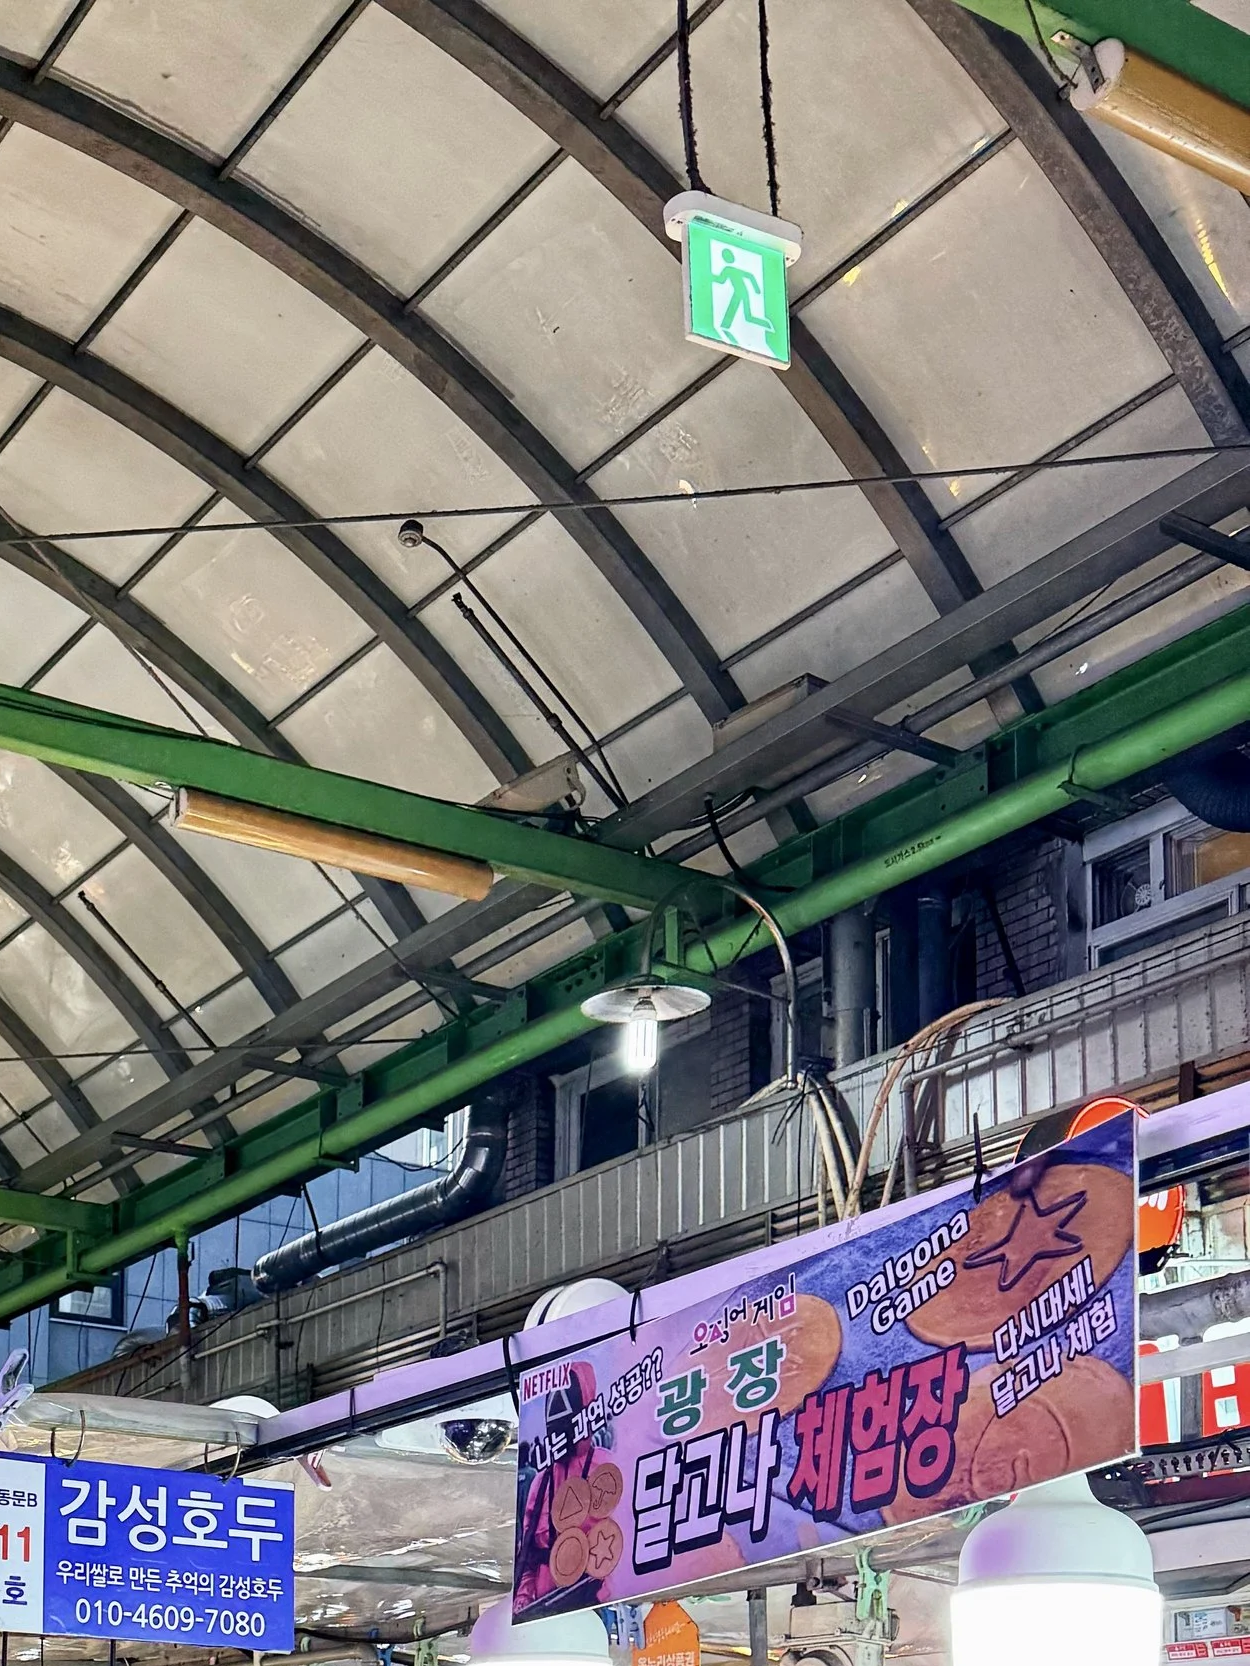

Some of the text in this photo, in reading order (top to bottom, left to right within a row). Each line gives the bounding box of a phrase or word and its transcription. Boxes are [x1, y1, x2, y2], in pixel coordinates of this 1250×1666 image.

[847, 1209, 970, 1320] Dalgona
[871, 1257, 957, 1335] Game
[689, 1272, 799, 1356] 오징어 게임
[994, 1256, 1096, 1363] 다시대세!
[522, 1359, 571, 1404] NETFLIX
[991, 1337, 1062, 1418] 달고나
[1067, 1291, 1117, 1359] 체험
[535, 1347, 664, 1472] 나는 과연 성공??
[635, 1412, 780, 1566] 달고나
[789, 1344, 969, 1515] 체험장
[59, 1479, 283, 1563] 감성호두
[2, 1576, 28, 1606] 호
[56, 1560, 284, 1602] 우리쌀로 만든 추억의 감성호두
[75, 1598, 265, 1637] 010-4609-7080
